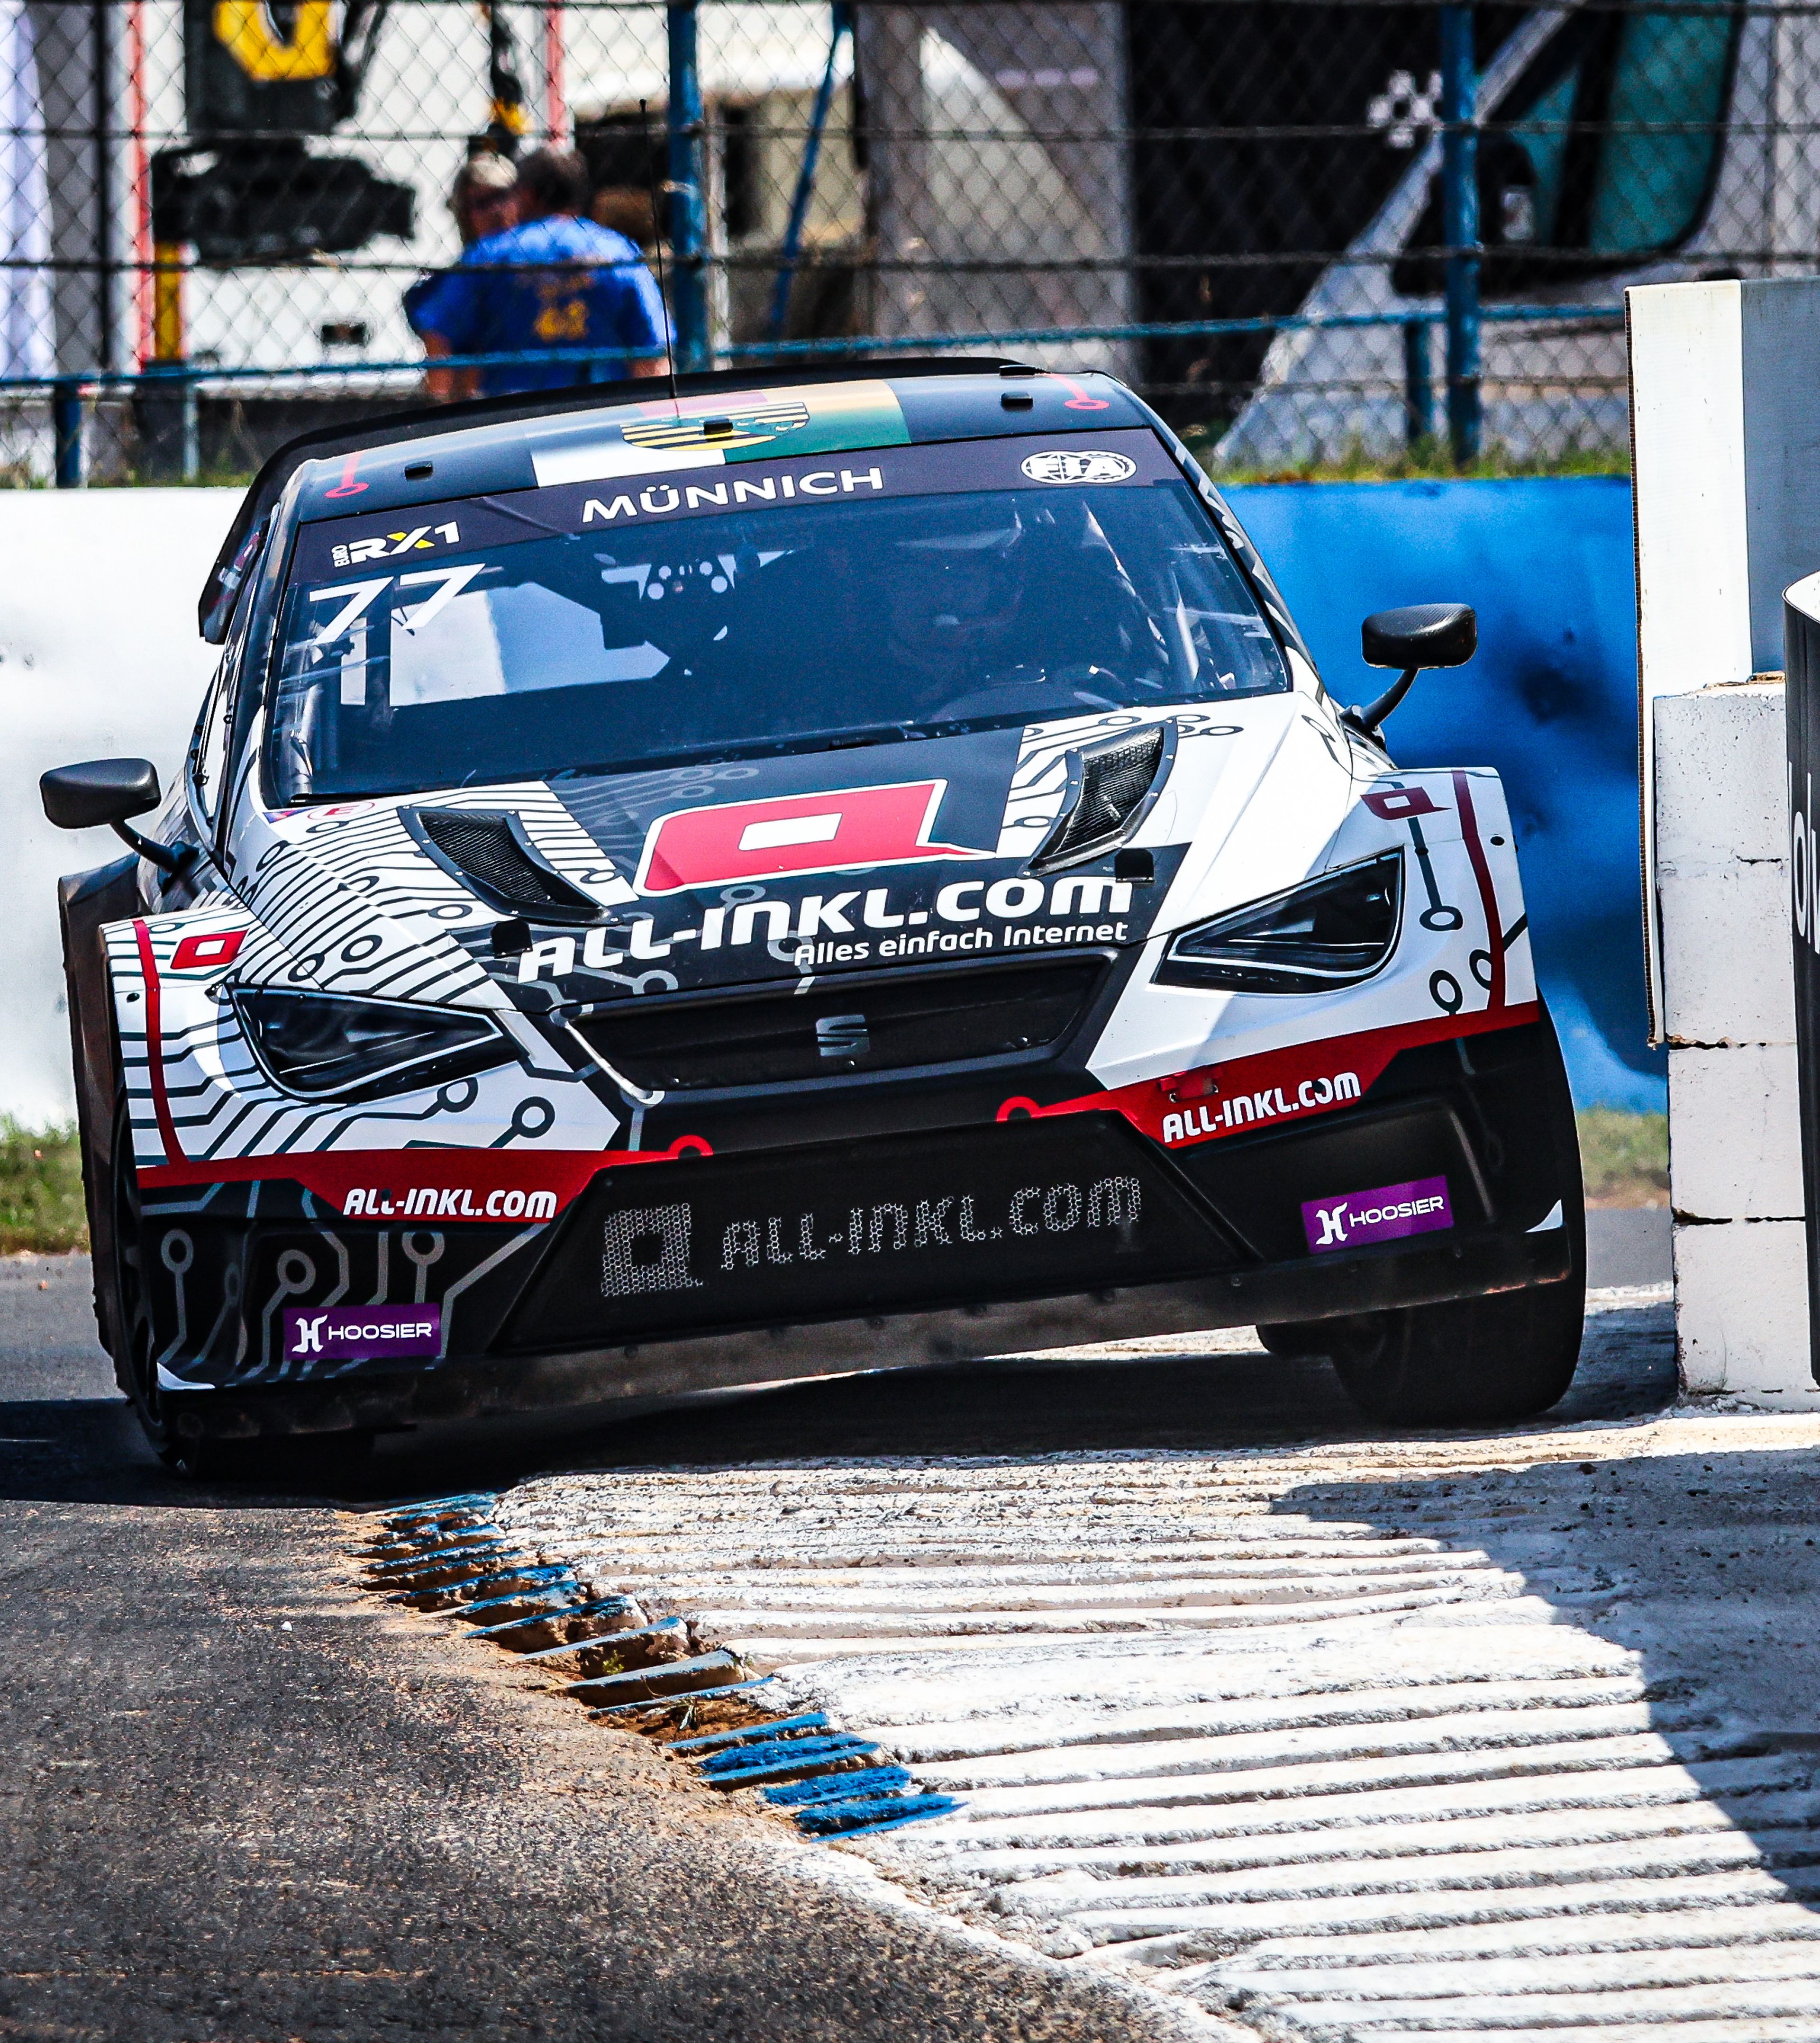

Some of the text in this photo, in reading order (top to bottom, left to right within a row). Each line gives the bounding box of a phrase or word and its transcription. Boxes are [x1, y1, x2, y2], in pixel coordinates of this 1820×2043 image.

[1029, 457, 1120, 476] FIA
[582, 468, 883, 523] MÜNNICH
[349, 521, 460, 564] RX1
[309, 563, 486, 645] 77
[794, 921, 1128, 966] Alles einfach Internet
[1163, 1071, 1361, 1144] ALL-INKL.COM
[1349, 1195, 1445, 1227] HOOSIER
[328, 1322, 433, 1341] HOOSIER
